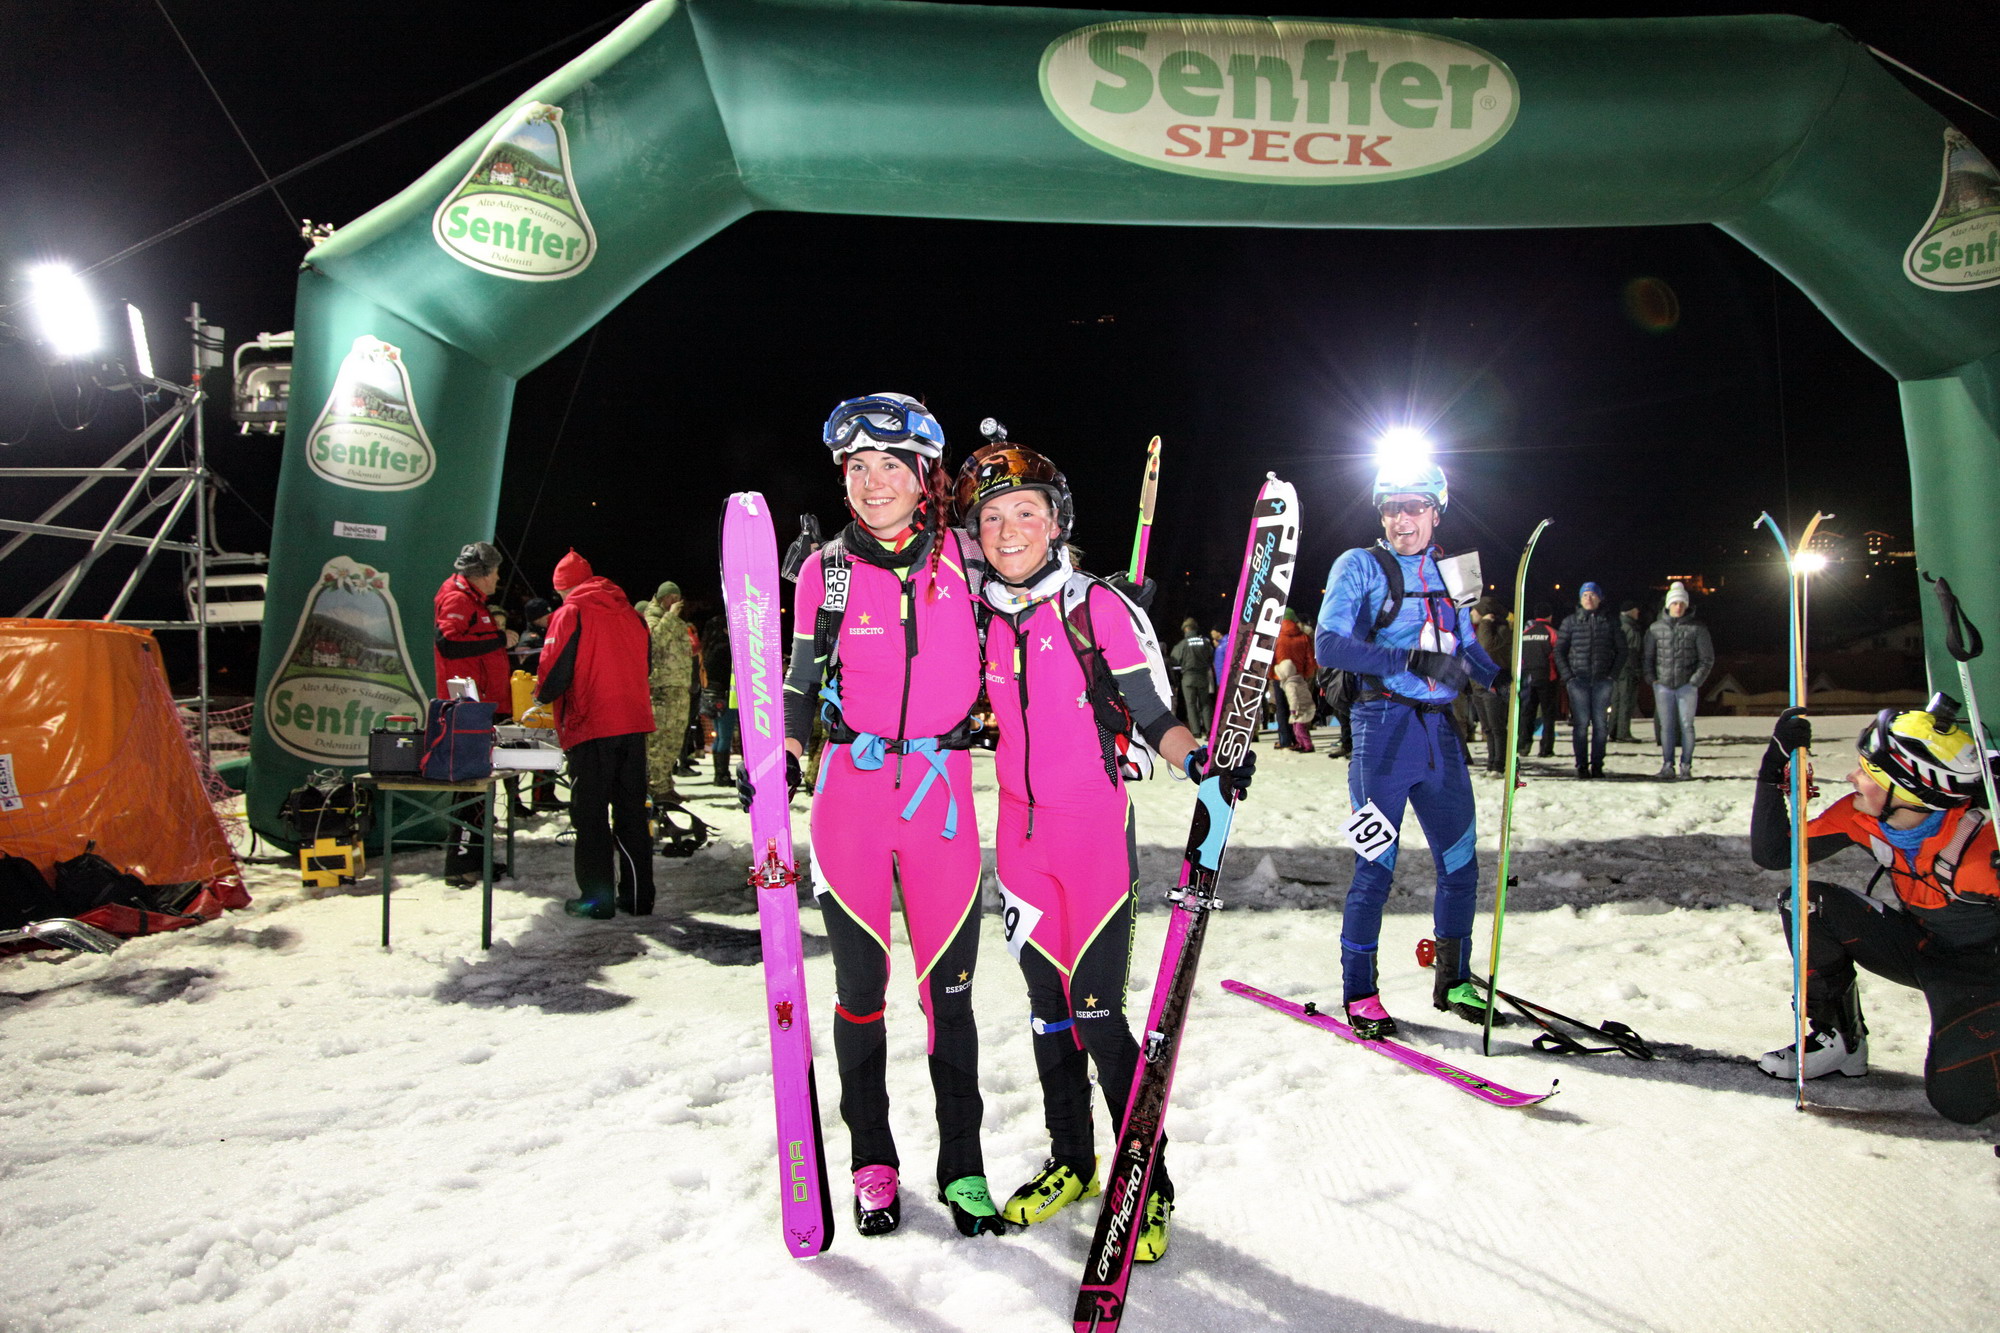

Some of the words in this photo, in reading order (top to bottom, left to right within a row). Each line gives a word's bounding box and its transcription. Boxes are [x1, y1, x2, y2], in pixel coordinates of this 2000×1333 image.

[1087, 30, 1491, 130] Senfter
[1164, 123, 1393, 167] SPECK
[477, 199, 494, 207] Alto
[498, 200, 523, 212] Adige
[529, 207, 567, 228] Südtirol
[447, 205, 582, 262] Senfter
[491, 251, 533, 267] Dolomiti
[315, 434, 423, 474] Senfter
[849, 627, 885, 635] ESERCITO
[744, 573, 772, 738] DYNAFIT
[301, 683, 320, 692] Alto
[321, 683, 351, 696] Adige
[358, 687, 401, 704] Südtirol
[314, 738, 362, 750] Dolomiti
[1348, 812, 1393, 853] 197
[1076, 1009, 1110, 1019] ESERCITO
[1035, 1189, 1063, 1215] SCARPA
